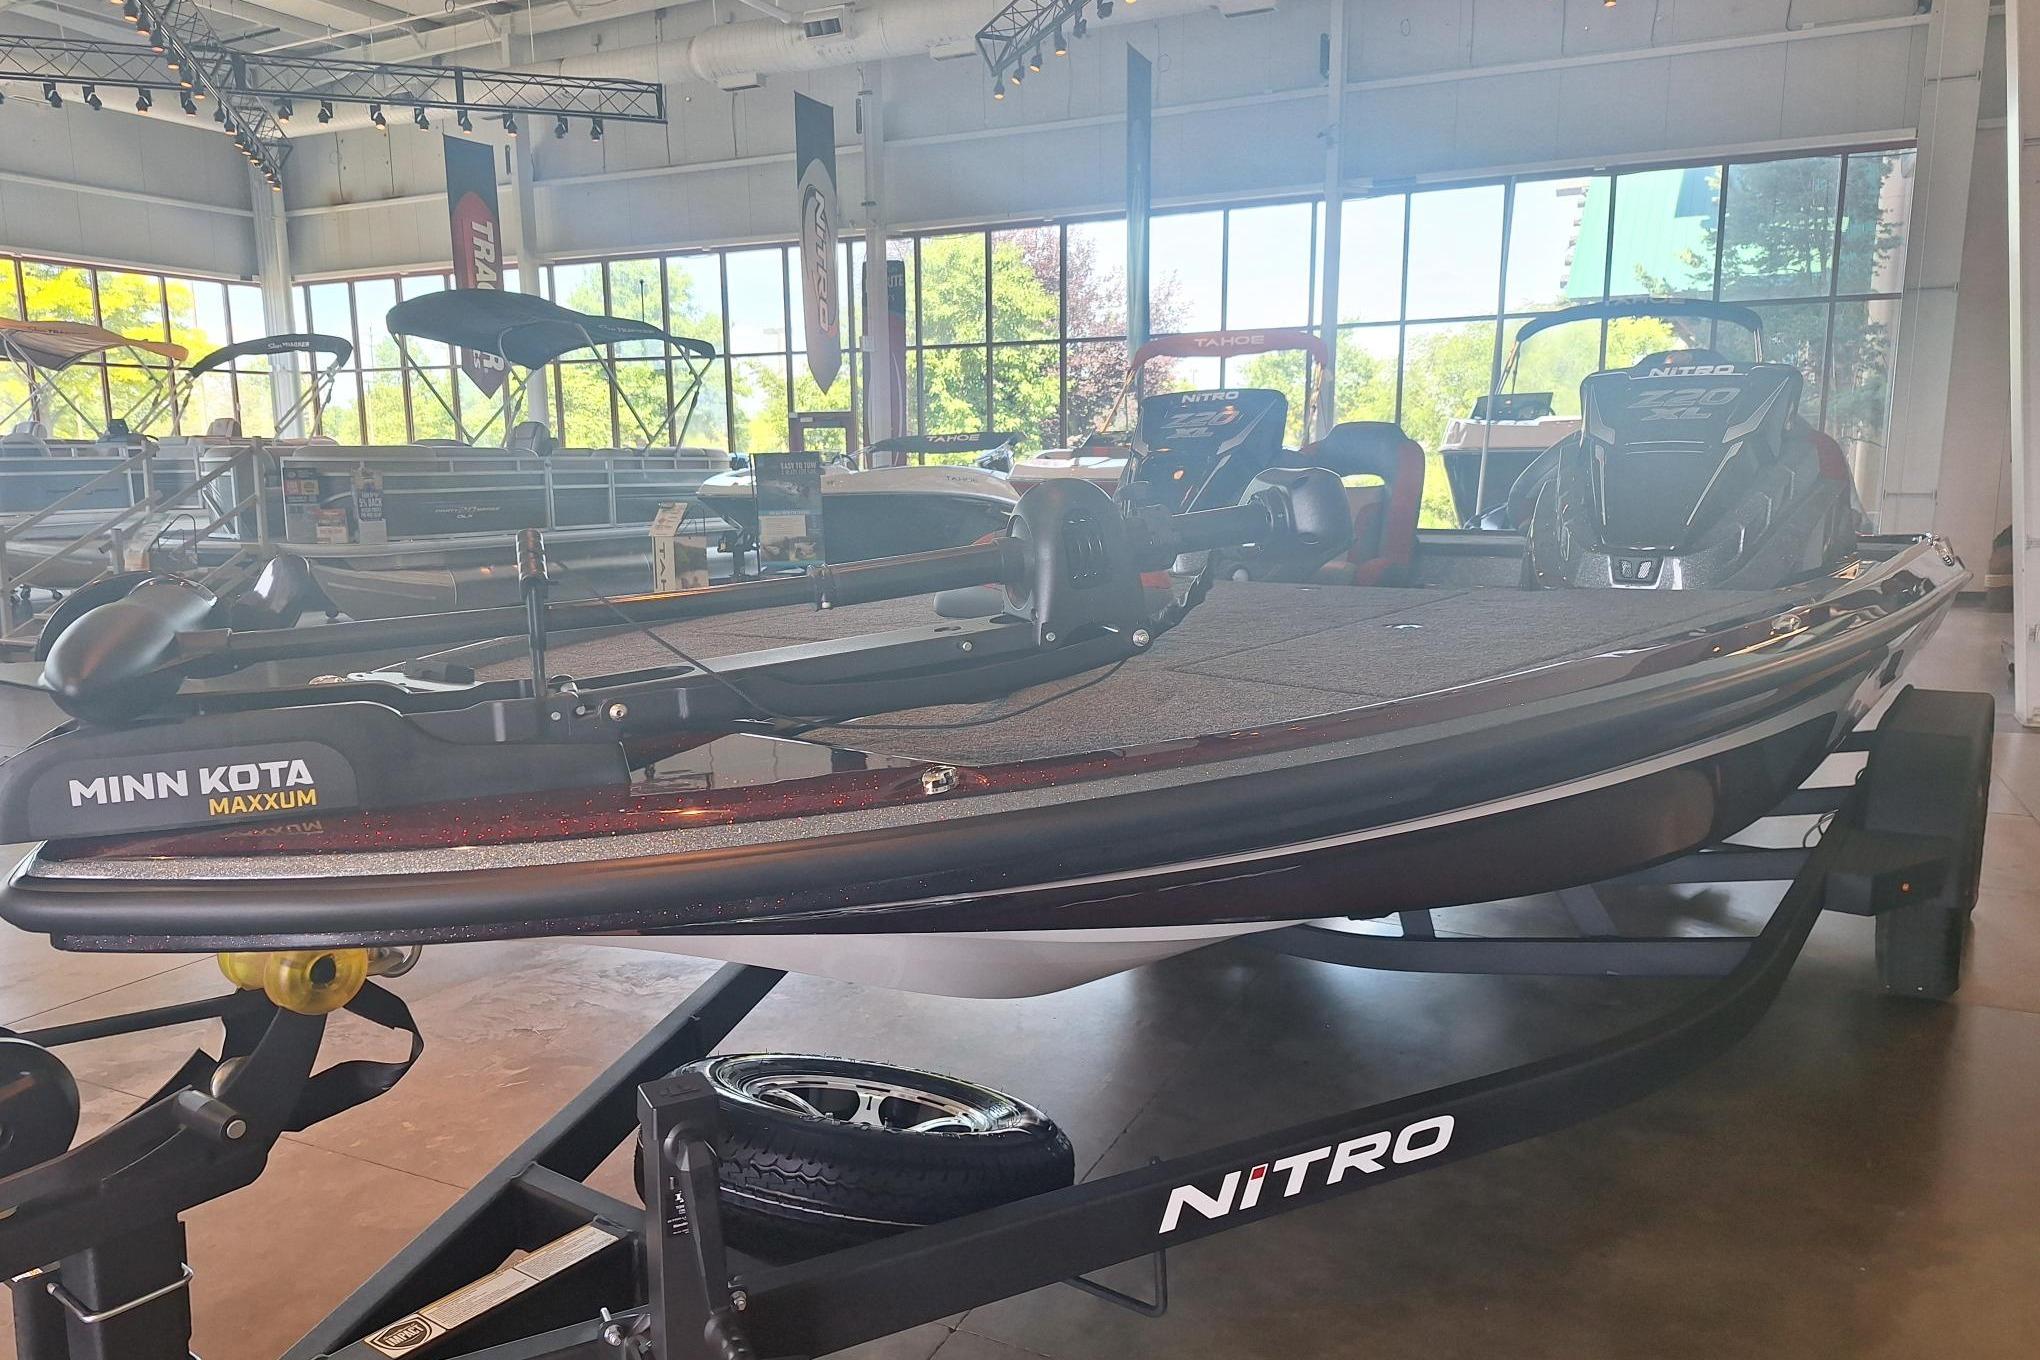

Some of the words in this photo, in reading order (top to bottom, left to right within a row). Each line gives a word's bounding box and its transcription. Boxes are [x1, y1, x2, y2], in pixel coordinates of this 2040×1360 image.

[813, 190, 829, 332] NITRO
[1194, 335, 1265, 348] TAHOE
[1649, 364, 1736, 377] NITRO
[1181, 391, 1240, 403] NITRO
[1626, 387, 1742, 409] Z20
[1640, 406, 1713, 421] XL
[925, 433, 981, 443] TAHOE
[659, 541, 667, 591] TAH
[69, 769, 189, 807] MINN
[200, 759, 314, 795] KOTA
[208, 788, 317, 816] MAXXUM
[1158, 1115, 1455, 1234] NITRO
[385, 1324, 424, 1346] IMPACT
